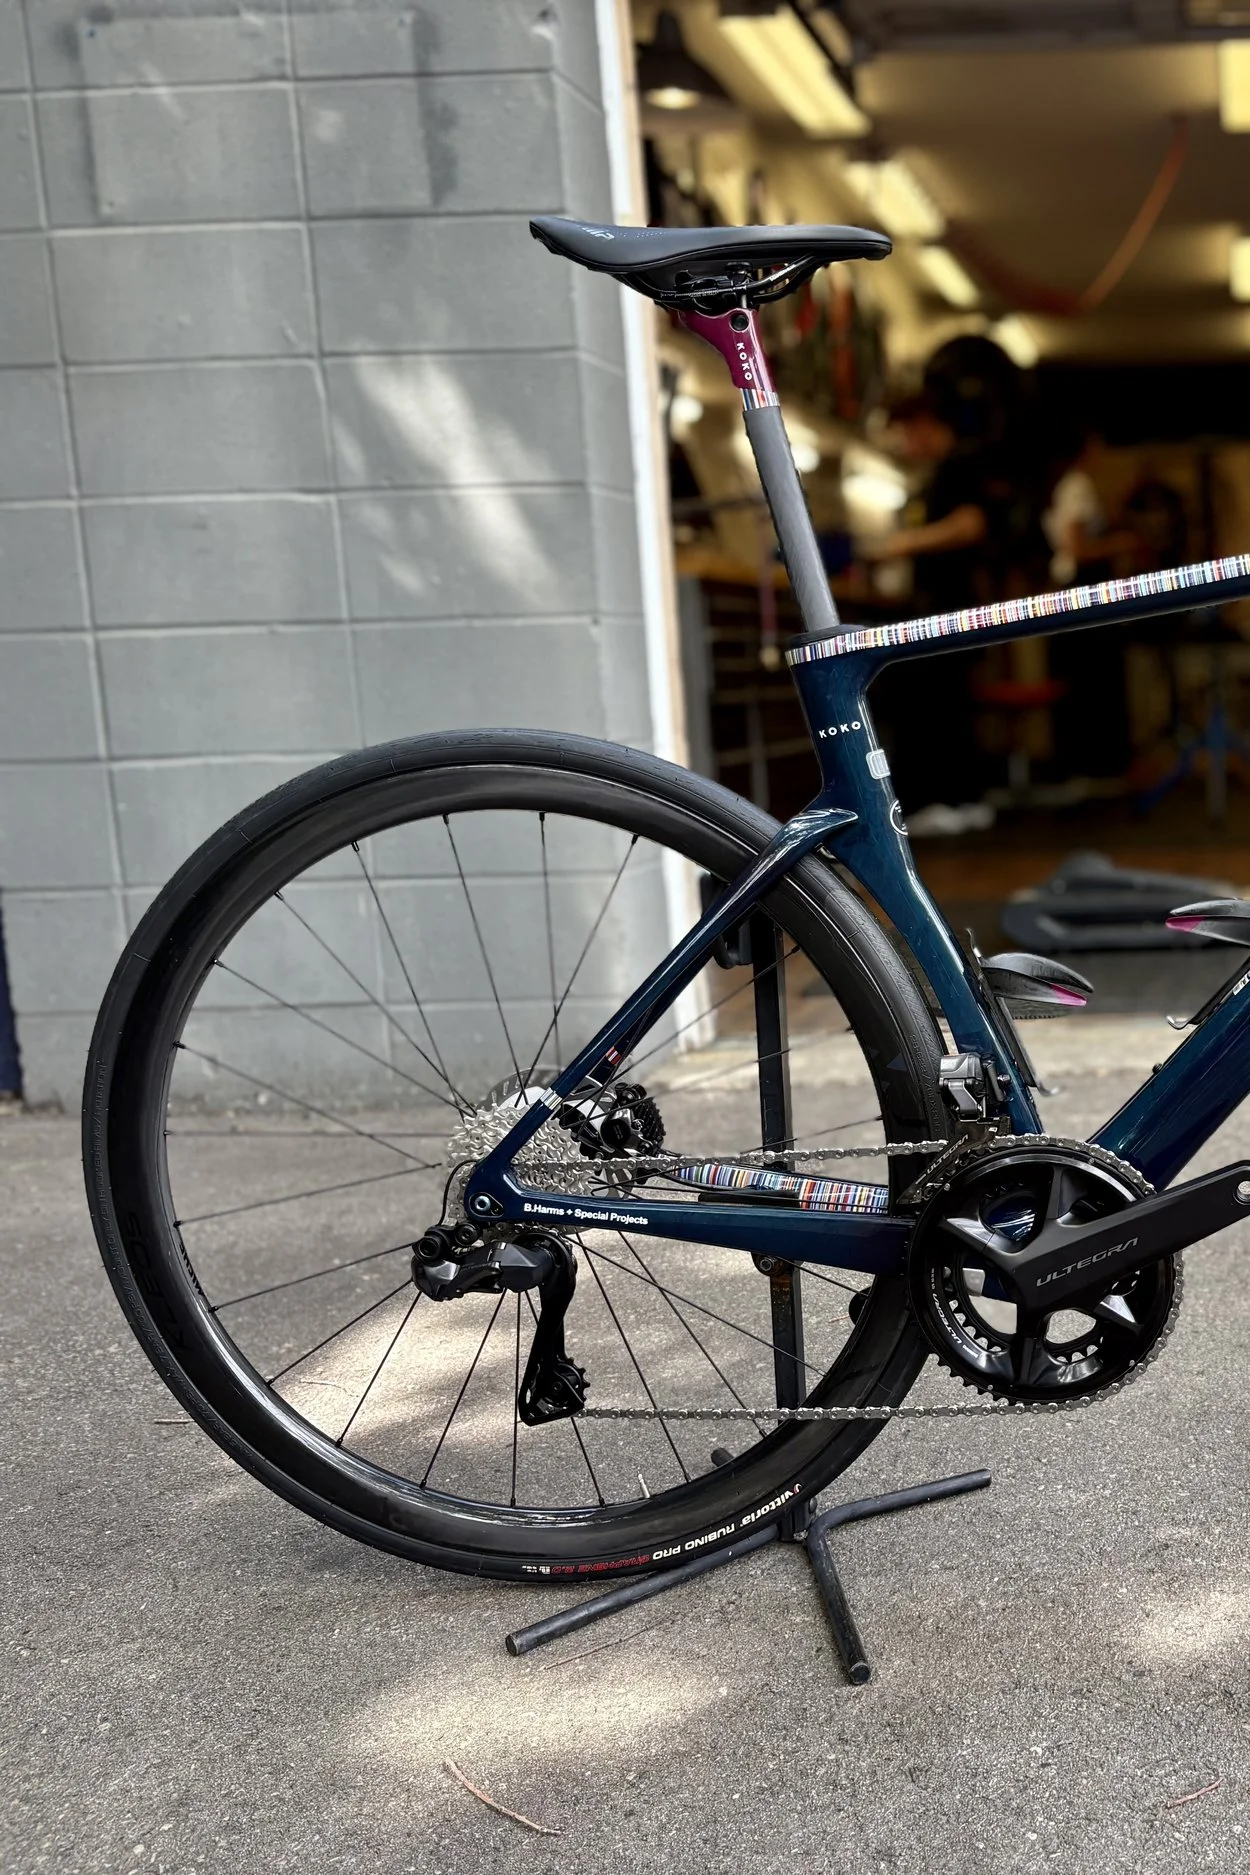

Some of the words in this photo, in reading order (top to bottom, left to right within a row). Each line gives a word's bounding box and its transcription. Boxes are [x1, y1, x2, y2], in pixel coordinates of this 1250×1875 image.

[736, 342, 752, 381] KOKO
[819, 721, 862, 739] KOKO
[523, 1202, 565, 1216] B.Harms
[574, 1209, 609, 1222] Special
[610, 1212, 649, 1225] Projects
[1036, 1237, 1138, 1287] ULTEGRA
[684, 1523, 735, 1550] RUBINO
[652, 1544, 681, 1560] PRO
